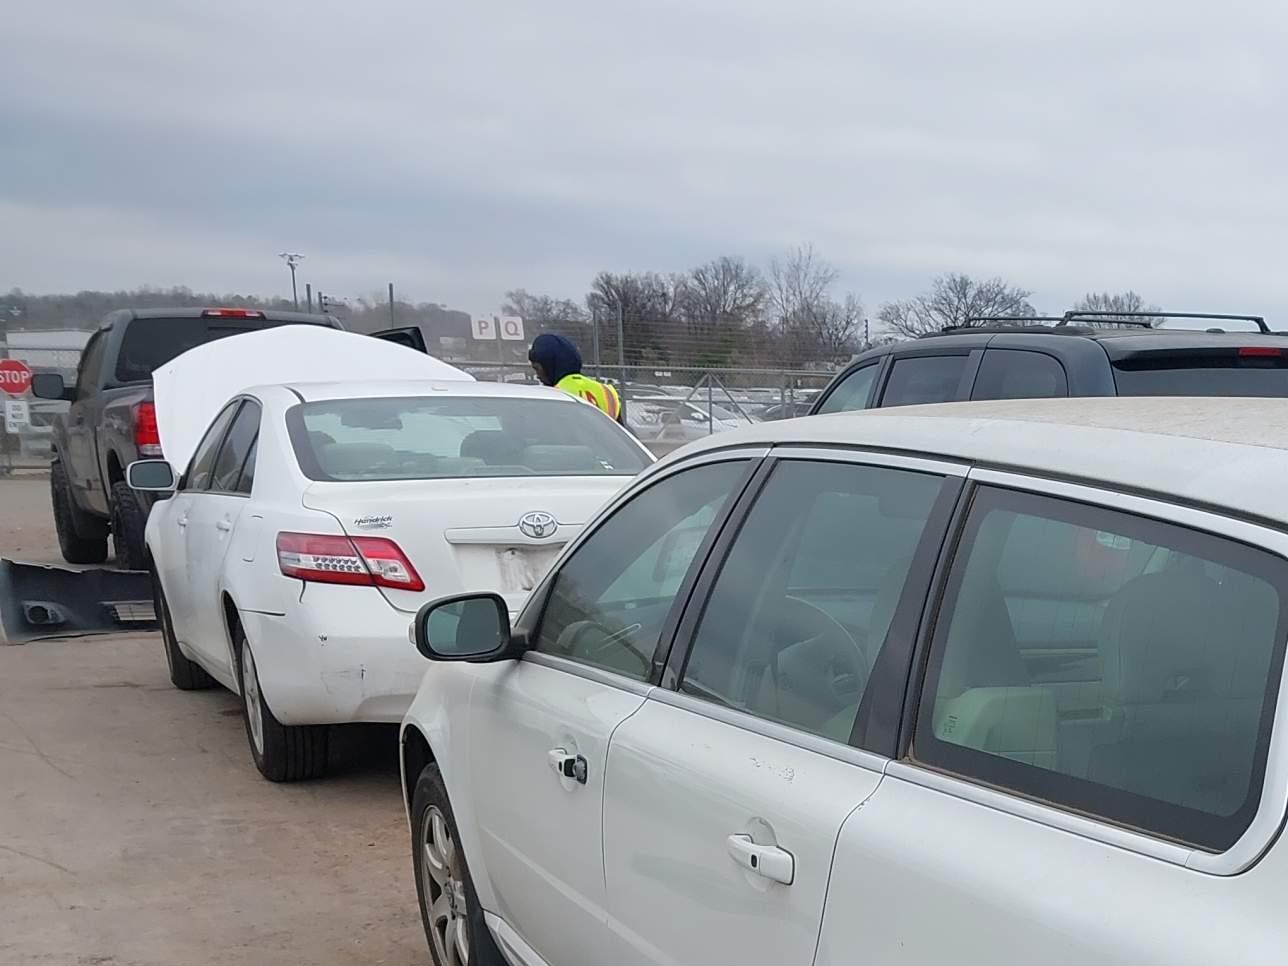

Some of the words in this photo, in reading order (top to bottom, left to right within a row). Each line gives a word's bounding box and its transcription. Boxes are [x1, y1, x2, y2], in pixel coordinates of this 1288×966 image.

[478, 319, 489, 336] P
[505, 320, 521, 336] Q
[0, 370, 29, 384] STOP
